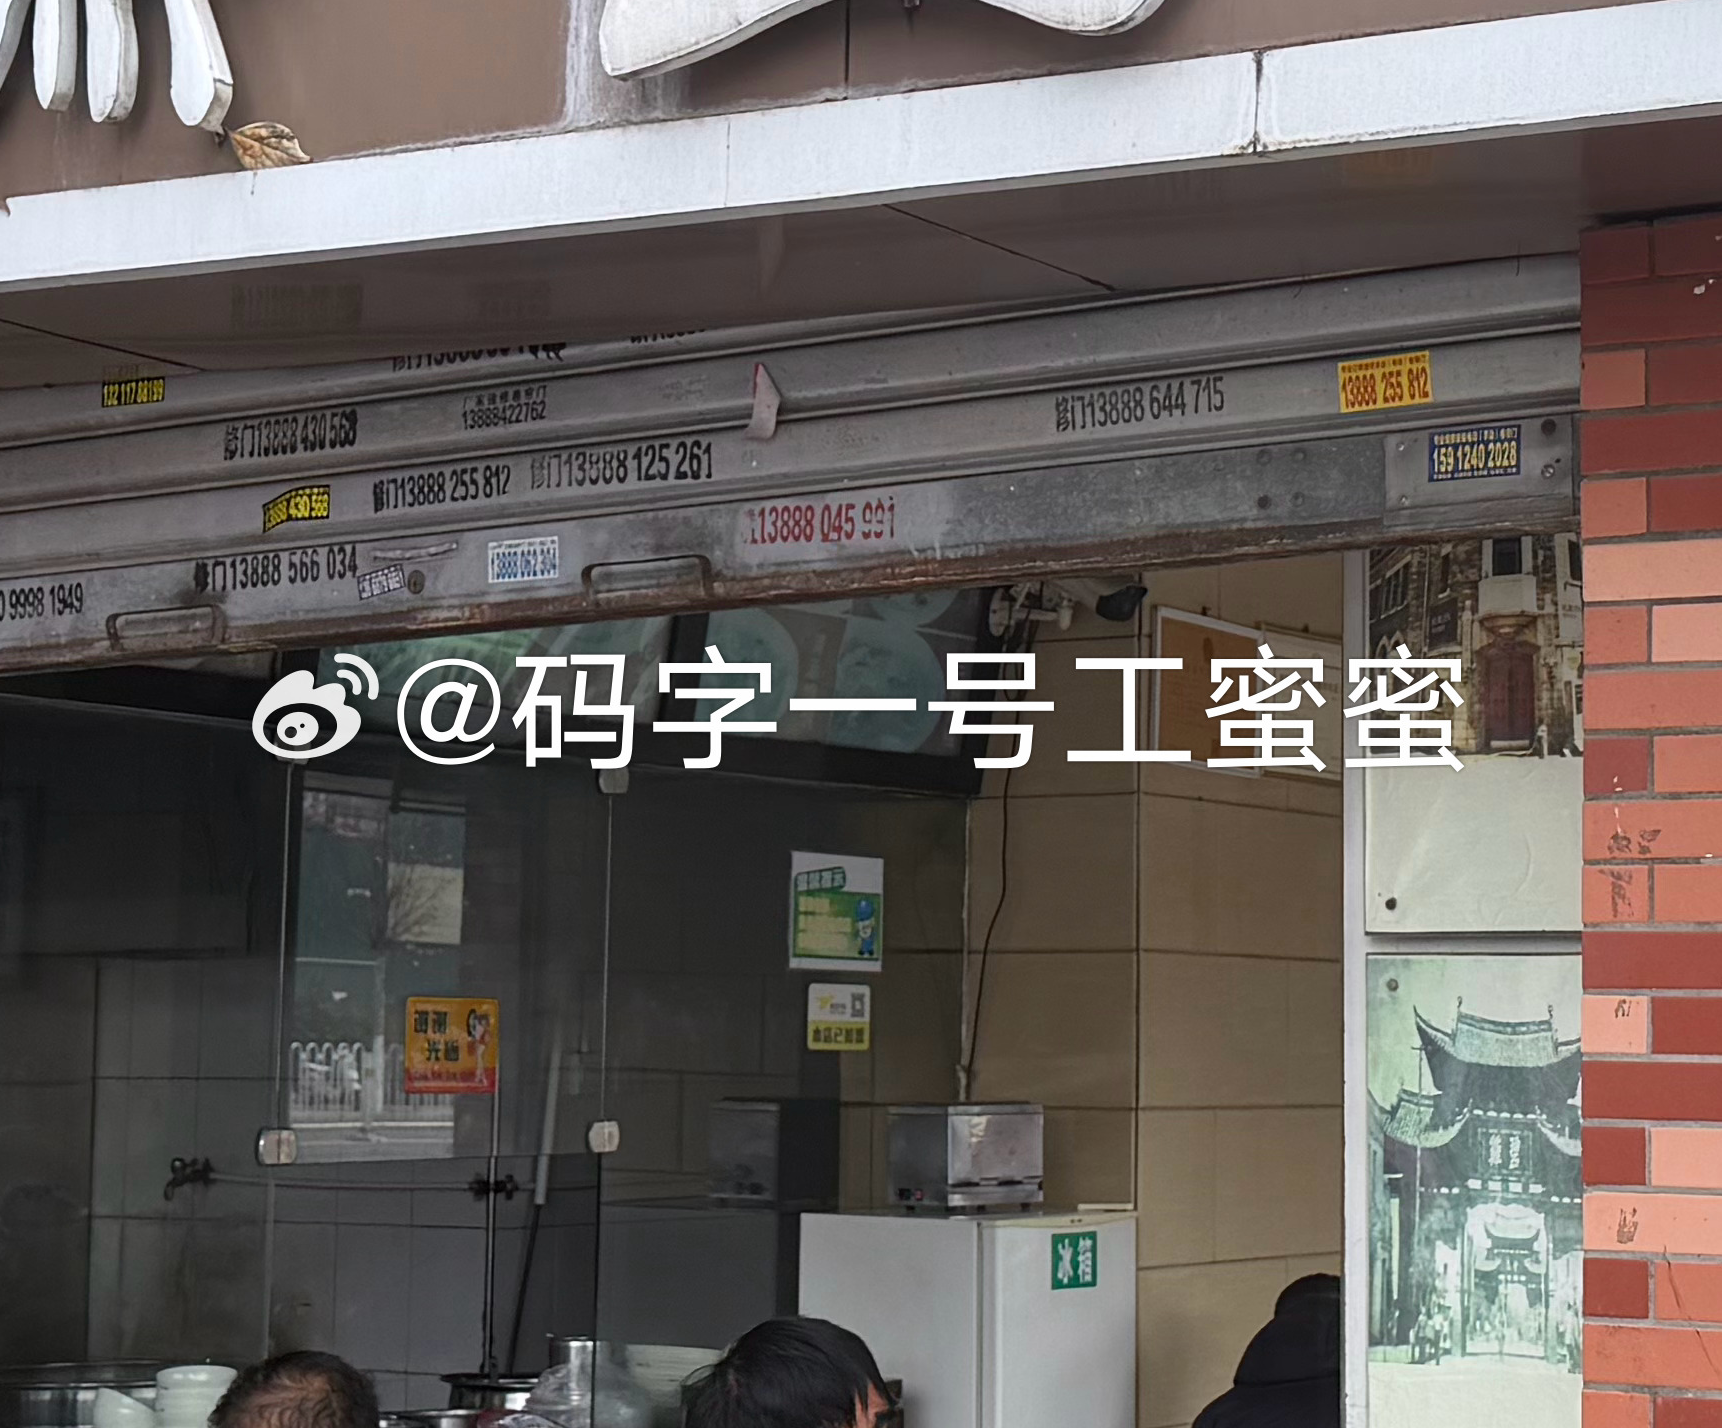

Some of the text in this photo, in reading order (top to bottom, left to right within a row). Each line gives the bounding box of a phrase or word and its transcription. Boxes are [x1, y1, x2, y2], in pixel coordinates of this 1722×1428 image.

[1149, 380, 1186, 420] 644
[1191, 376, 1225, 416] 715
[1341, 366, 1429, 409] 13888 255 812
[300, 411, 327, 452] 430
[631, 443, 670, 481] 125
[673, 439, 712, 480] 261
[1433, 440, 1517, 473] 159 1240 2028
[449, 467, 479, 503] 255
[482, 464, 511, 499] 812
[820, 501, 855, 542] 045
[288, 549, 320, 585] 566
[327, 544, 358, 580] 034
[9, 586, 44, 619] 9998
[49, 582, 83, 615] 1949
